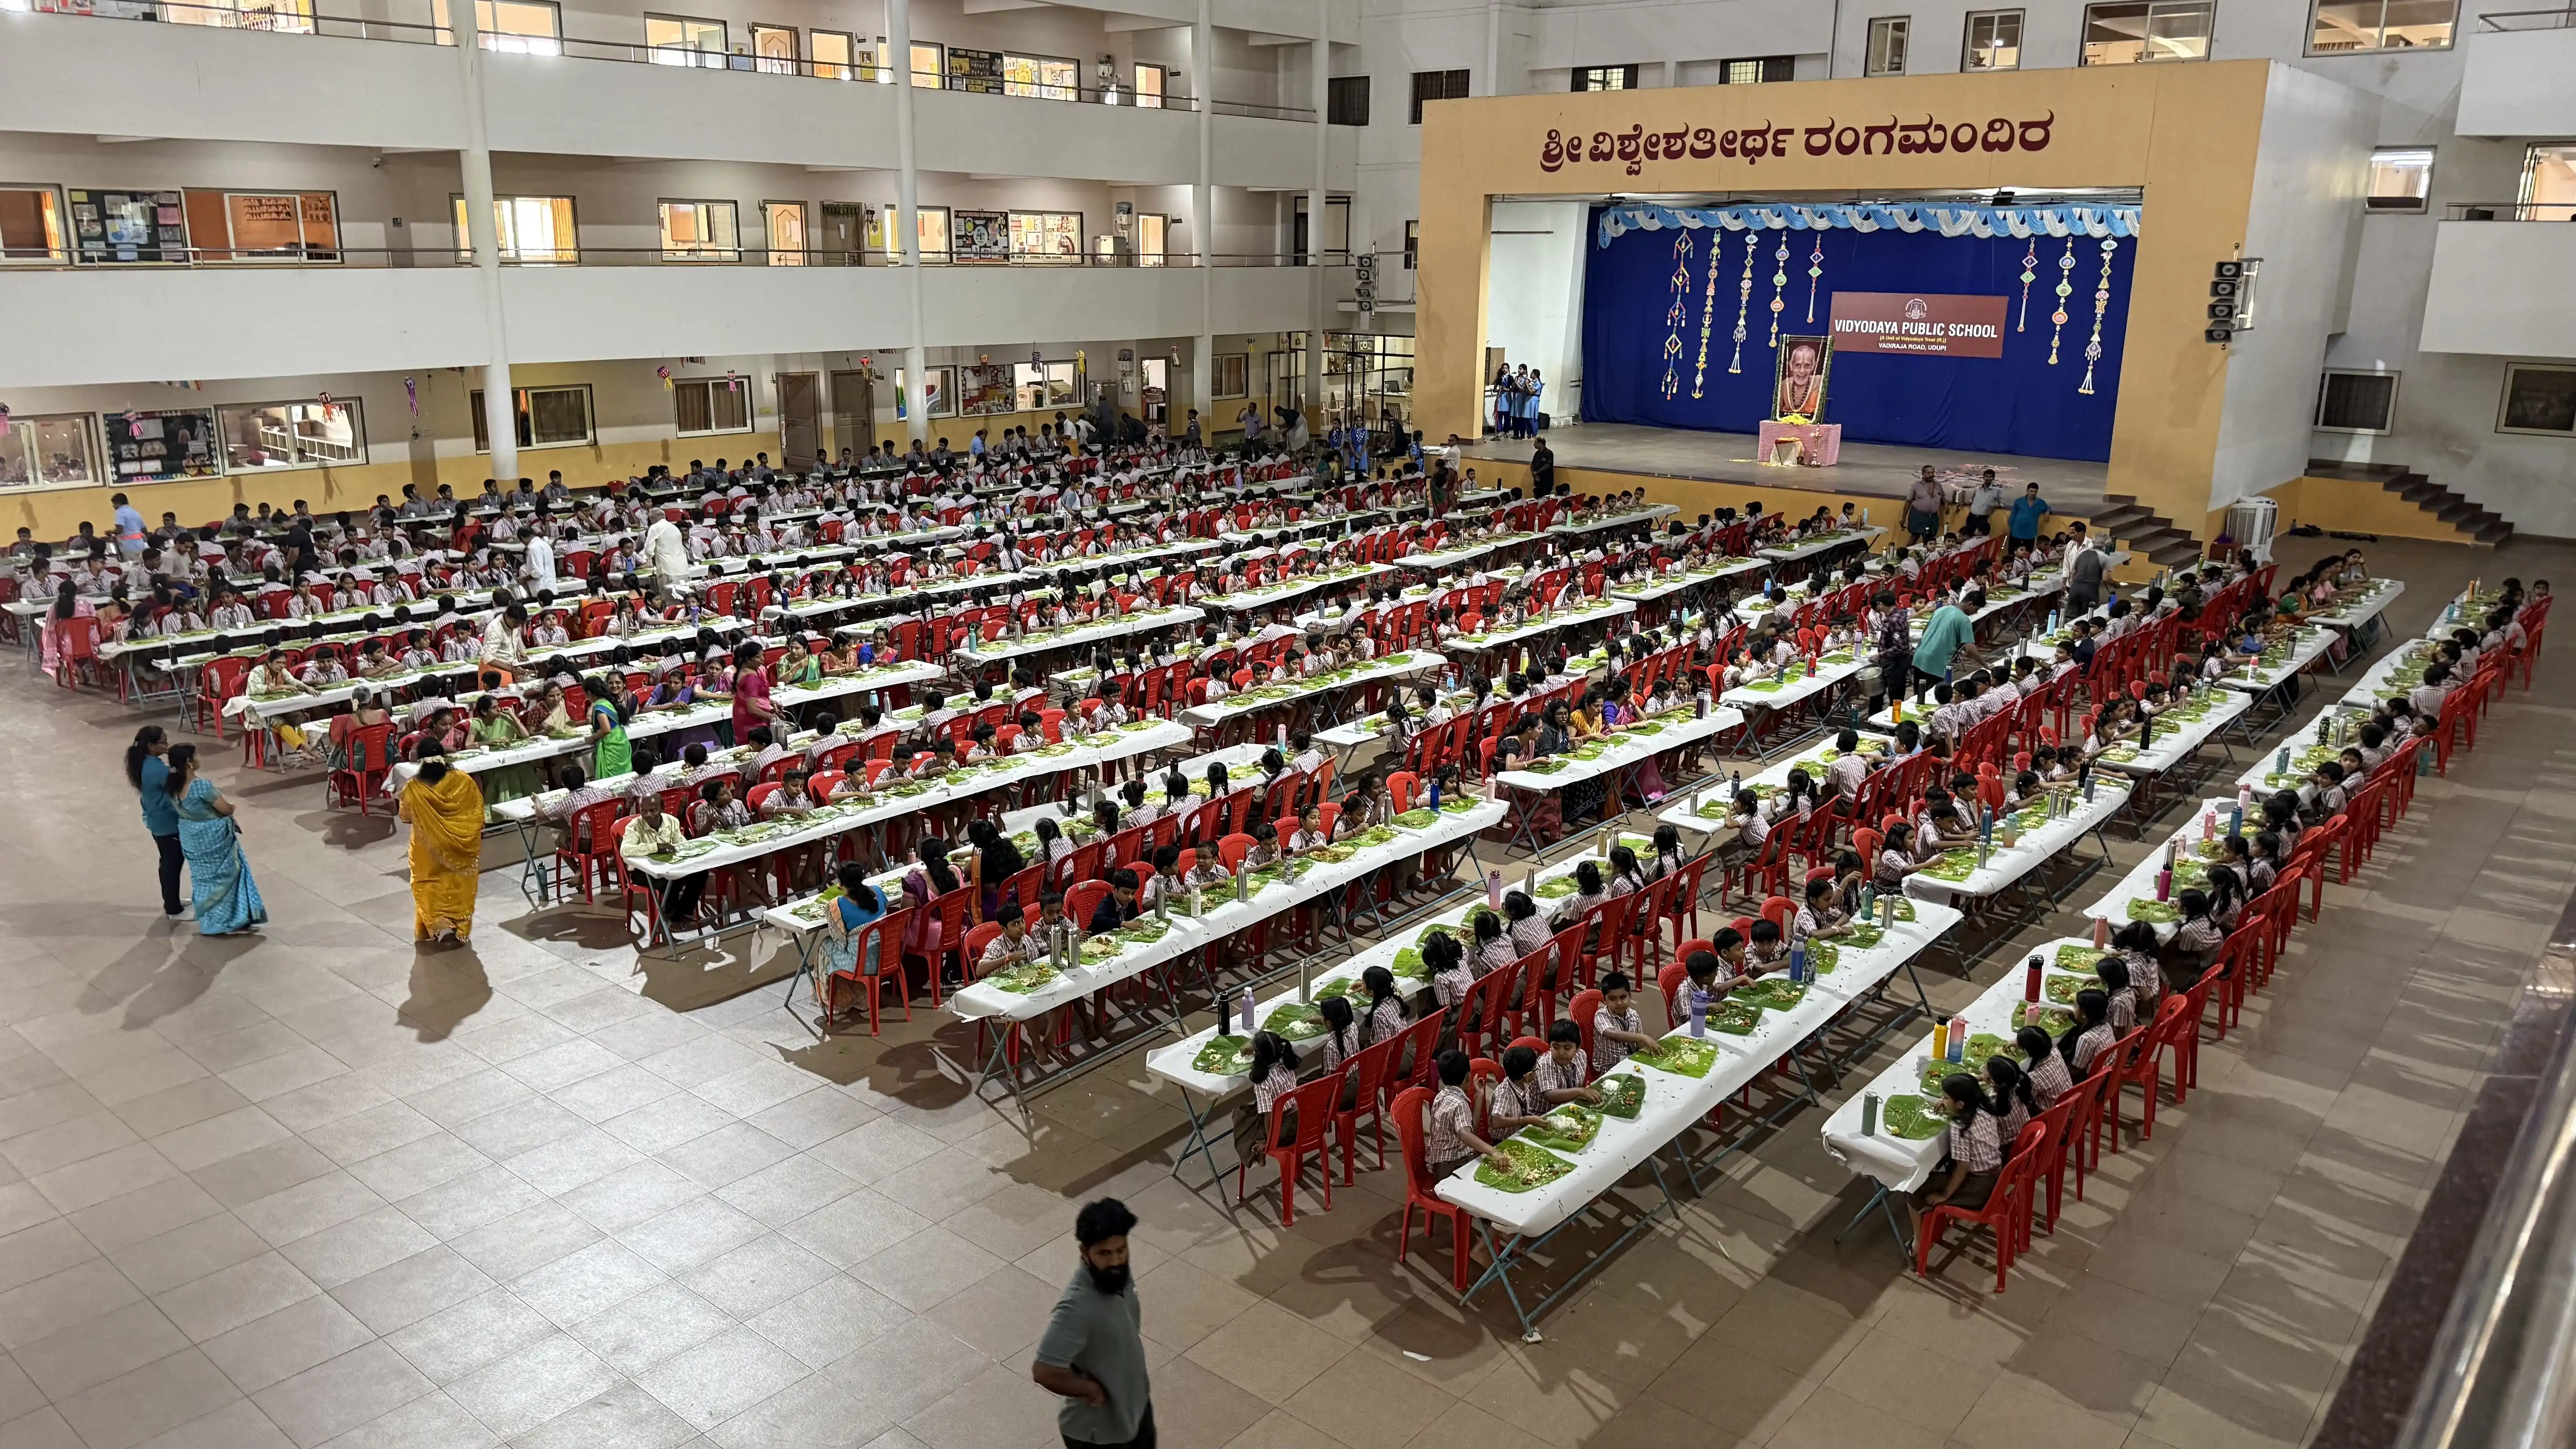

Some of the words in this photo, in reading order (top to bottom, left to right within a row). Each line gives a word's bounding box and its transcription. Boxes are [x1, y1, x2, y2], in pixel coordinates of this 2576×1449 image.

[1539, 129, 1582, 173] ಶ್ರೀ
[1588, 119, 1795, 176] ವಿಶ್ವೇಶತೀರ್ಥ
[1804, 109, 2055, 156] ರಂಗಮಂದಿರ
[1835, 319, 1898, 334] VIDYODAYA
[1902, 322, 1945, 336] PUBLIC
[1948, 323, 1998, 338] SCHOOL
